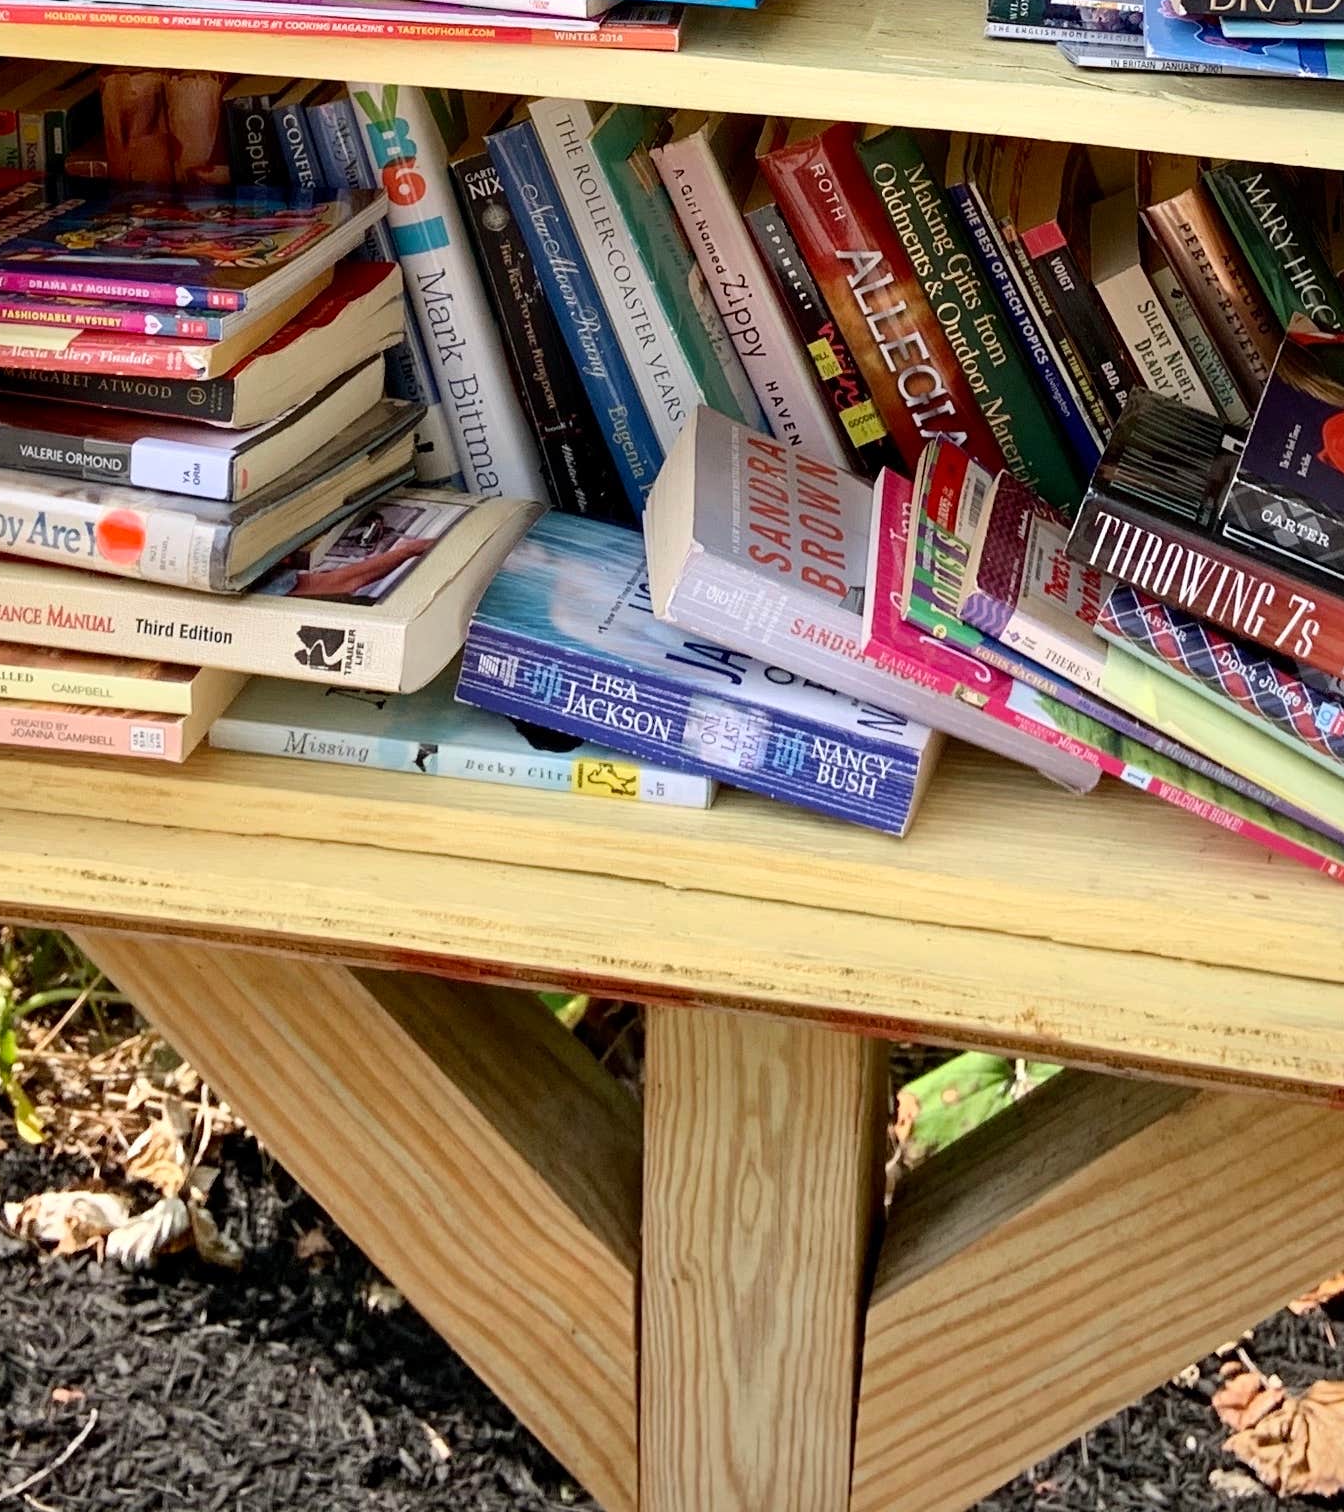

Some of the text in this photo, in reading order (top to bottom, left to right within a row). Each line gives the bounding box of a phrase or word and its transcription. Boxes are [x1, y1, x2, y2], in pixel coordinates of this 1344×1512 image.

[44, 11, 160, 25] HOLIDAY SLOW COOKER
[172, 16, 384, 33] FROM THE WORLD'S #1 COOKING MAGAZINE
[397, 25, 495, 37] TASTEOFHOME.COM
[555, 31, 623, 43] WINTER 2014
[1111, 60, 1223, 73] IN BRITAIN JANUARY 2001
[673, 169, 766, 359] A Girl Named Zippy
[766, 224, 812, 309] SPINELLI
[873, 163, 989, 396] Oddments & Outdoor
[904, 162, 1007, 368] Making Gifts from
[961, 198, 1049, 365] THE BEST OF TECH TOPICS
[3, 309, 72, 324] FASHIONABLE
[75, 314, 122, 327] MYSTERY
[417, 269, 464, 366] Mark
[97, 379, 172, 400] ATWOOD
[766, 381, 802, 446] HAVEN
[20, 444, 122, 470] VALERIE ORMOND
[748, 438, 793, 572] SANDRA
[31, 512, 81, 551] Are
[795, 454, 847, 598] BROWN
[1261, 510, 1330, 548] CARTER
[1088, 511, 1275, 638] THROWING
[136, 618, 232, 644] Third Edition
[52, 683, 112, 698] CAMPBELL
[591, 675, 638, 701] LISA
[1219, 650, 1256, 681] Don't
[1258, 674, 1300, 705] Judge
[1305, 704, 1313, 713] a
[562, 681, 674, 742] JACKSON
[283, 730, 369, 763] Missing
[812, 739, 893, 778] NANCY
[816, 762, 876, 799] BUSH
[1160, 783, 1242, 832] WELCOME HOME!
